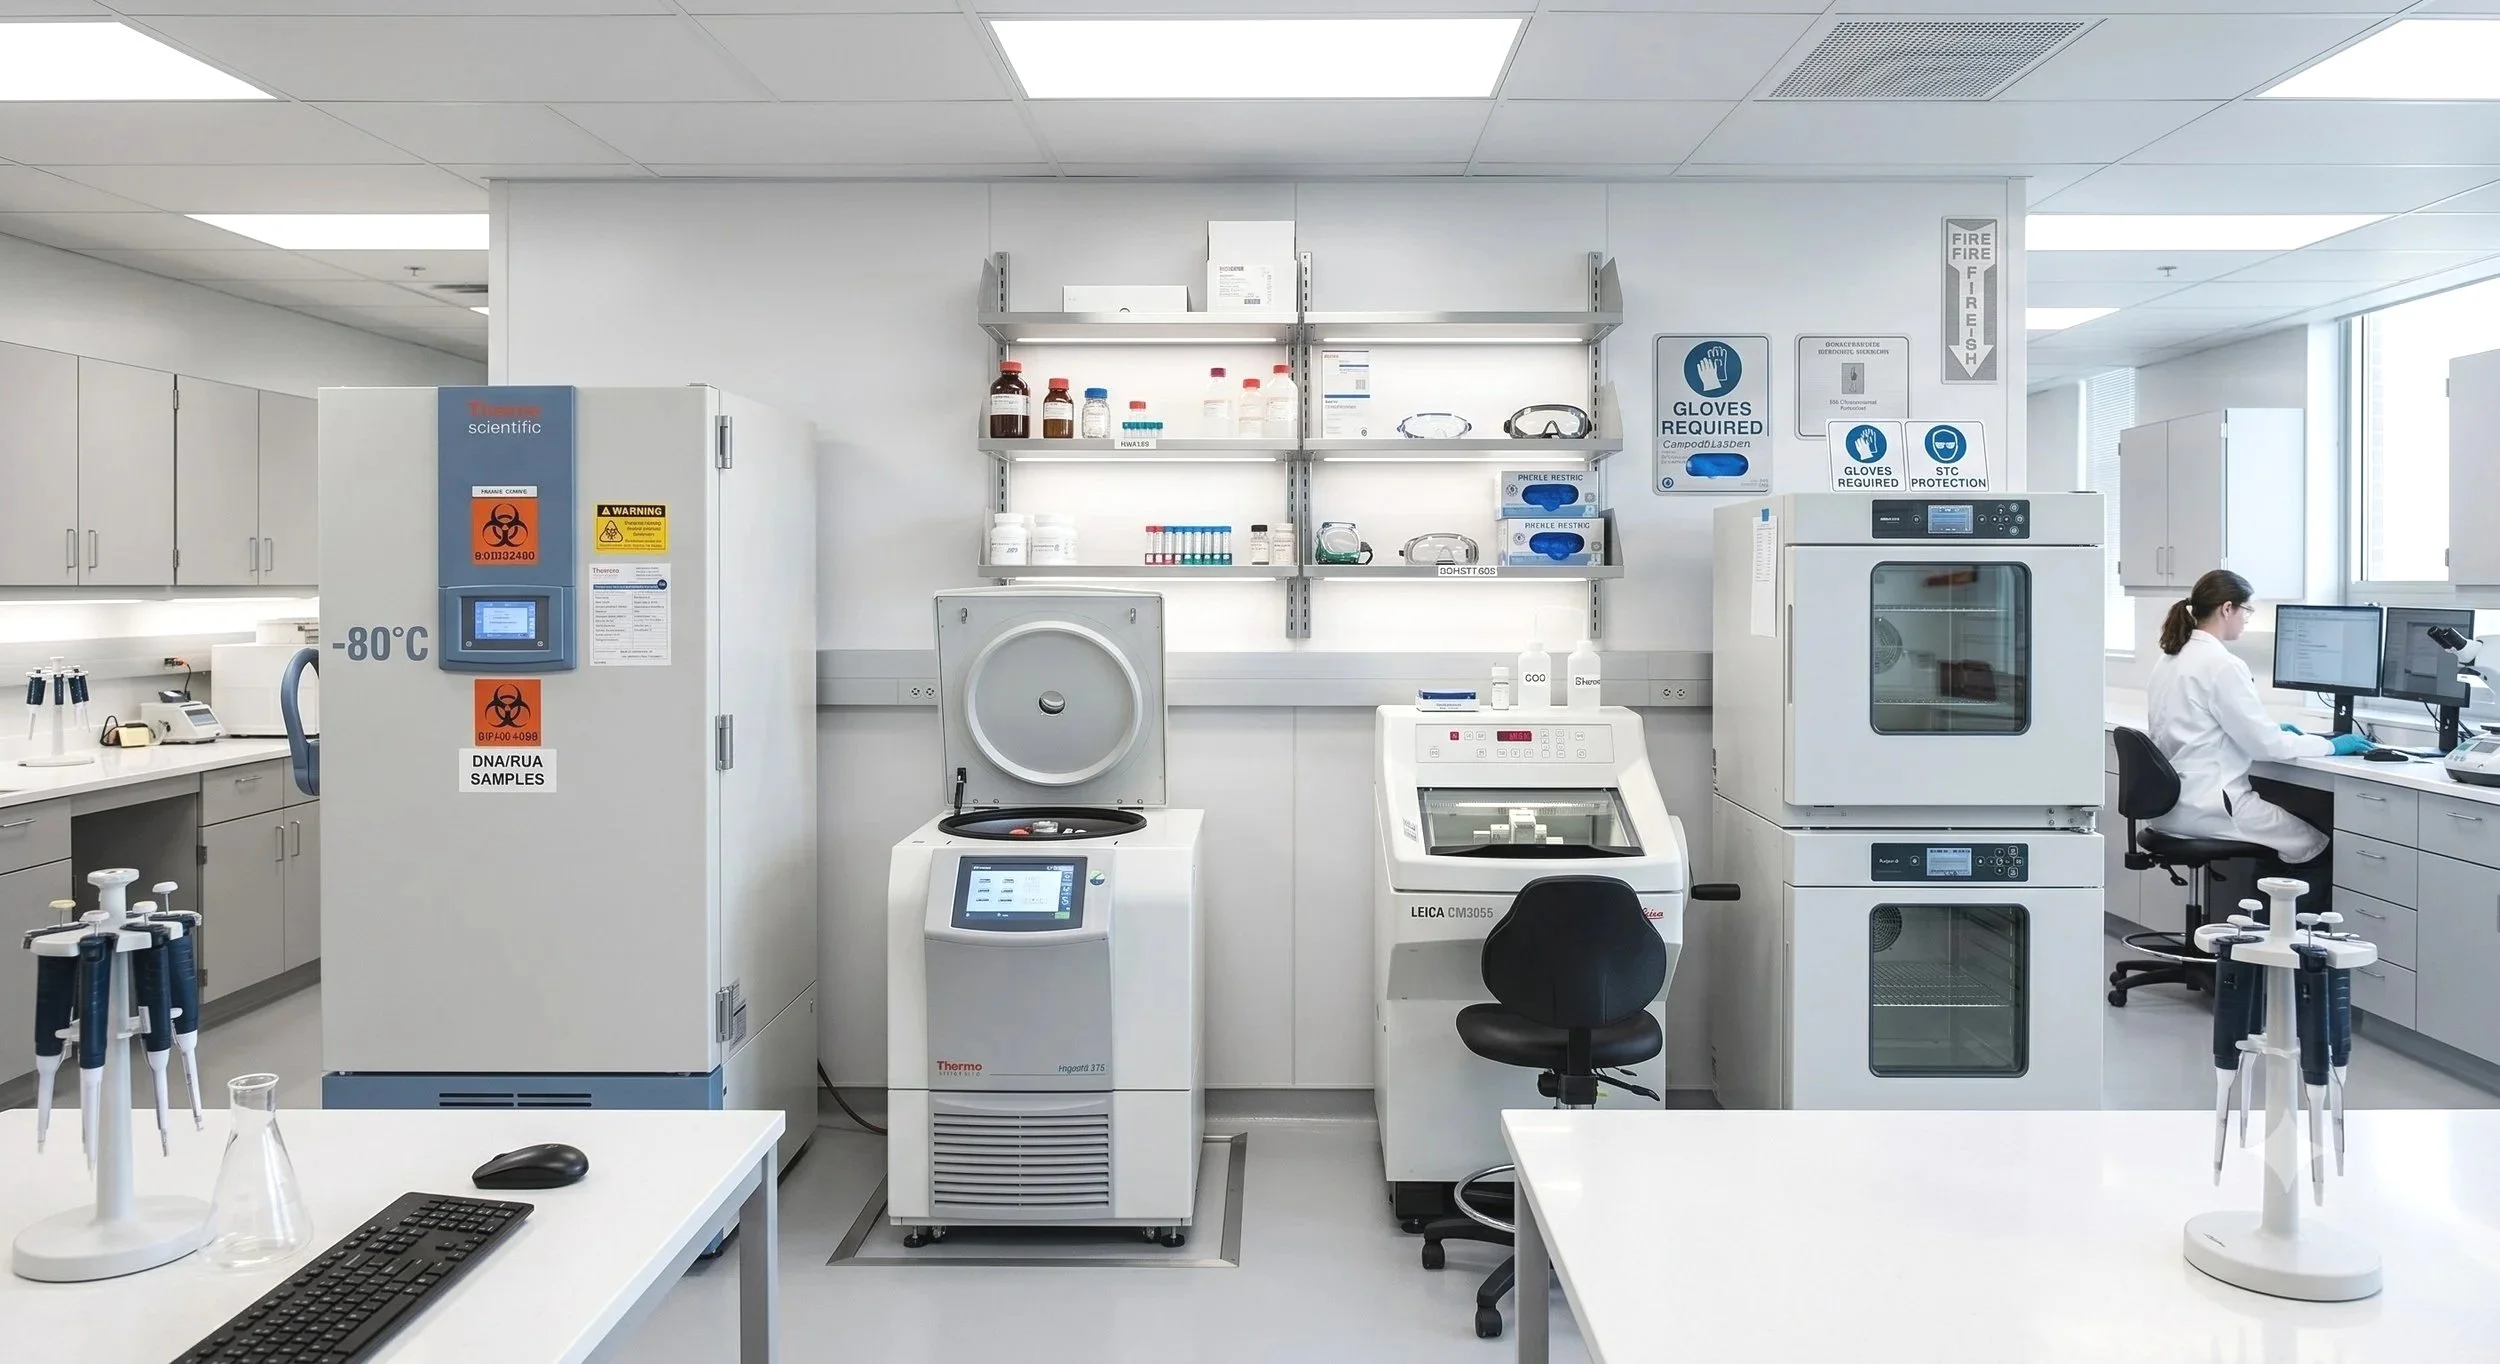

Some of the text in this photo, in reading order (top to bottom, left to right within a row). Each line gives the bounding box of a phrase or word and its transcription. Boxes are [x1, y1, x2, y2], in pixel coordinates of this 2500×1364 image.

[1952, 233, 1991, 245] FIRE
[1952, 248, 1991, 260] FIRE
[1673, 401, 1751, 416] GLOVES
[468, 420, 541, 434] scientific
[1661, 420, 1763, 435] REQUIRED
[1844, 466, 1892, 476] GLOVES
[1935, 466, 1959, 476] STC
[1911, 478, 1986, 488] PROTECTION
[612, 506, 663, 516] WARNING
[332, 625, 429, 662] -80°C
[472, 754, 543, 768] DNA/RUA
[470, 772, 545, 786] SAMPLES
[1411, 906, 1494, 918] LEICA CM3055
[936, 1060, 982, 1071] Thermo
[1090, 1063, 1105, 1072] 375
